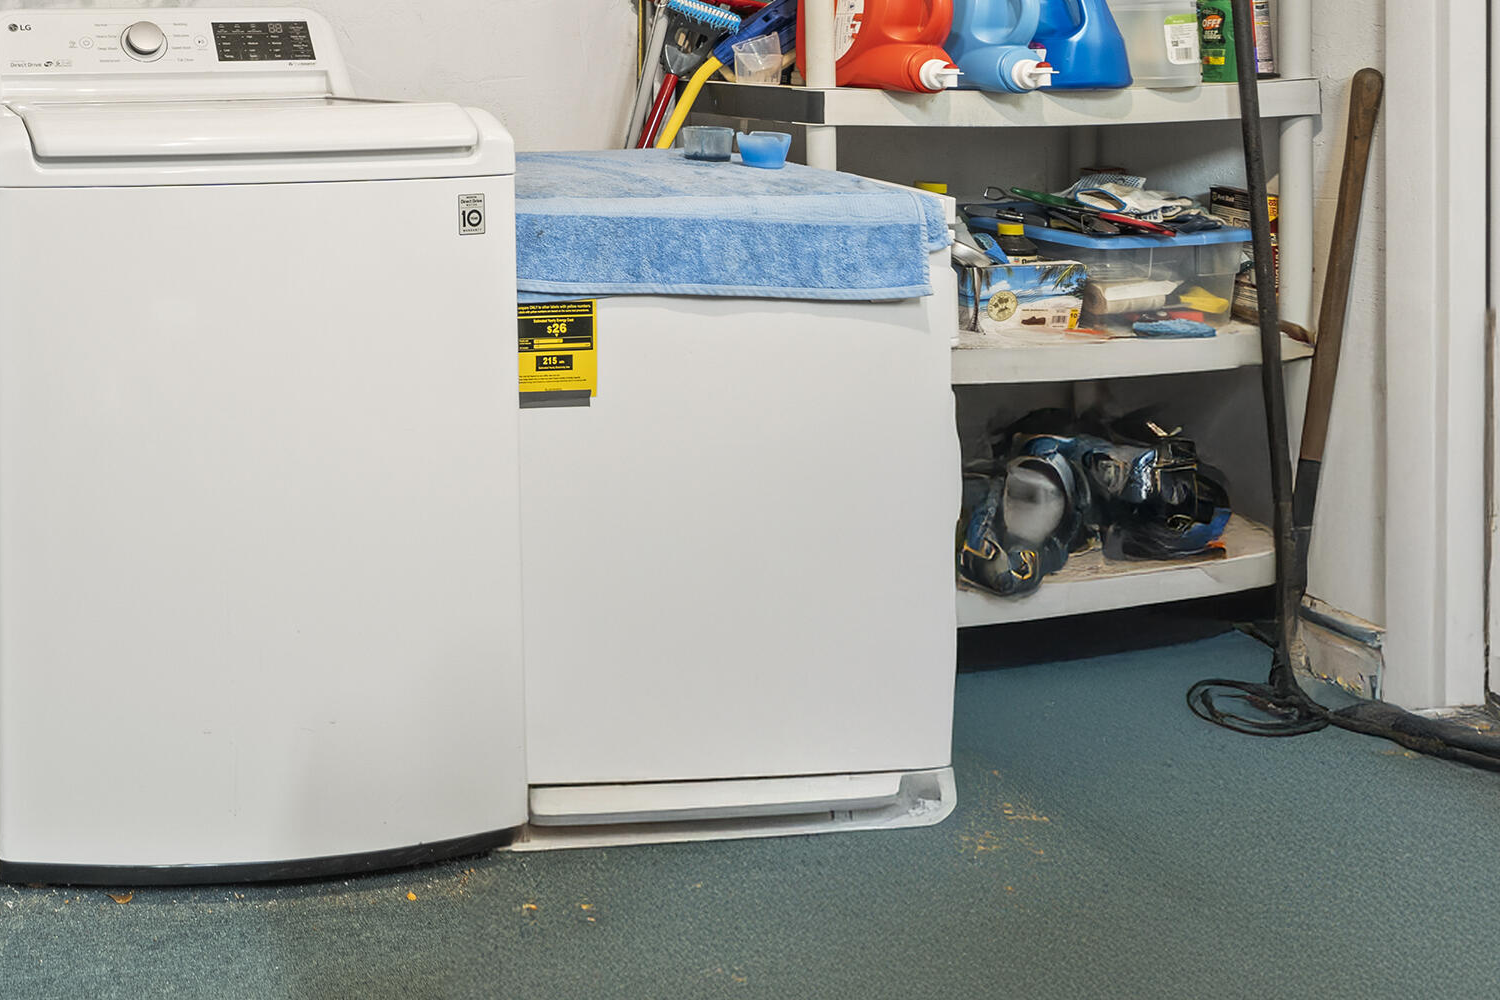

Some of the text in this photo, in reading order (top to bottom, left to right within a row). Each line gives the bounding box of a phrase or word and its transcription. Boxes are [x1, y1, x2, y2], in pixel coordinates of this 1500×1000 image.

[1201, 17, 1223, 29] OFF!
[546, 323, 568, 334] $26
[542, 356, 558, 365] 215
